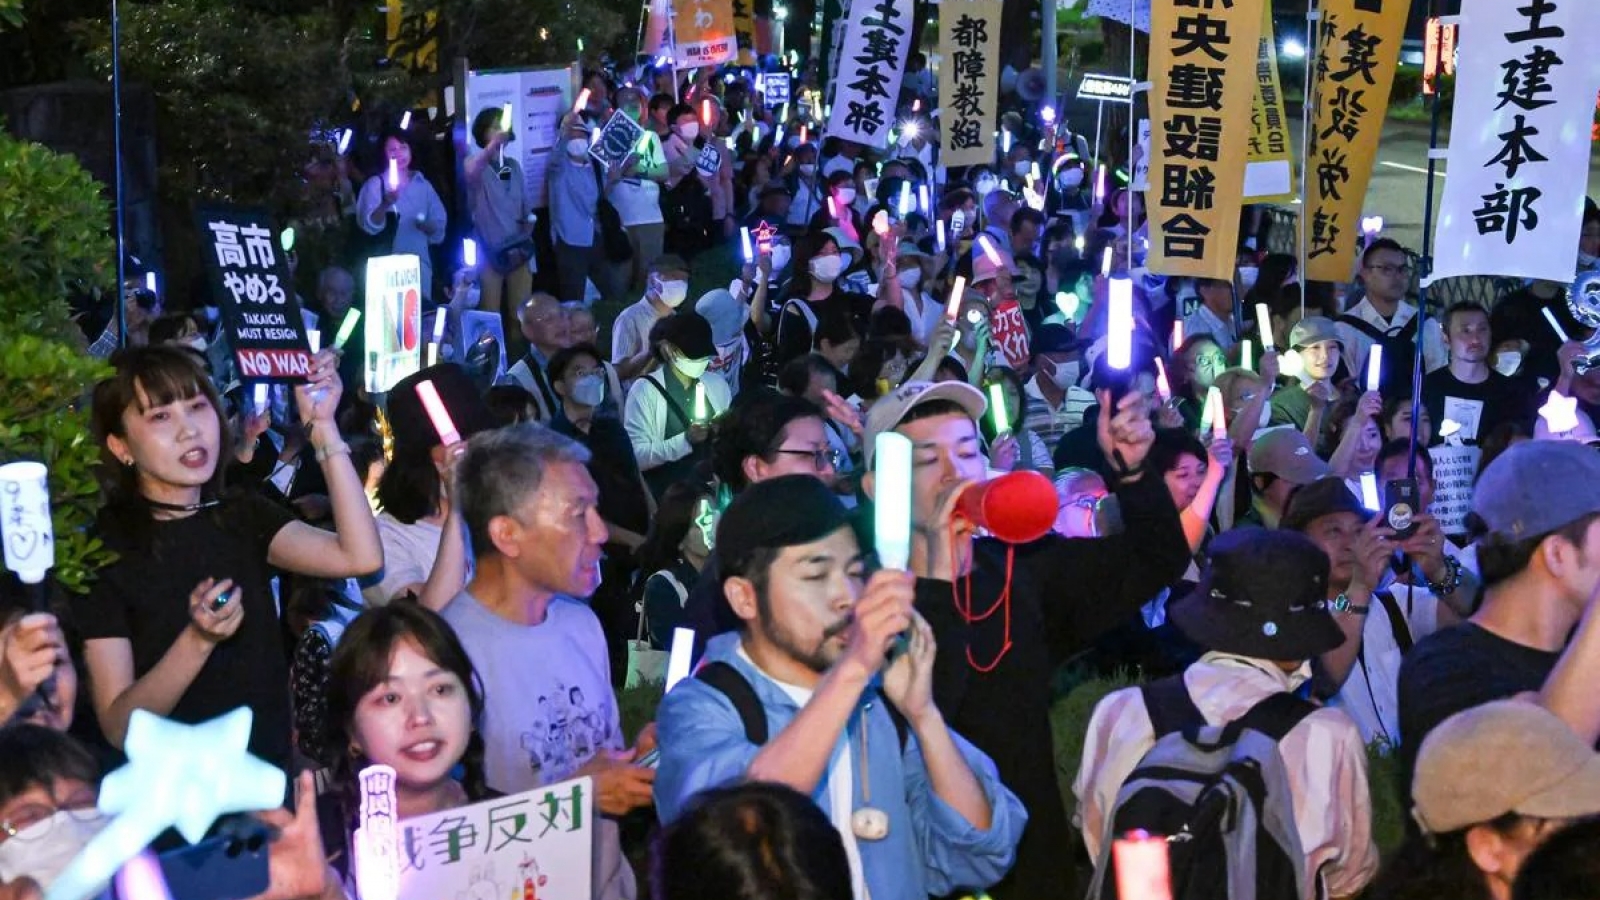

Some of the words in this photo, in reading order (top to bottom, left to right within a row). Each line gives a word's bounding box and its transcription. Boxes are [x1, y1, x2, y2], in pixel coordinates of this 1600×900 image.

[949, 14, 988, 151] 都障教組
[1472, 0, 1565, 244] 土建本部
[209, 221, 275, 268] 高市
[224, 271, 286, 304] やめろ
[237, 328, 261, 340] MUST
[264, 329, 298, 340] RESIGN
[243, 313, 286, 325] TAKAICHI
[992, 307, 1022, 334] 力で
[238, 352, 271, 375] NO
[272, 352, 311, 375] WAR
